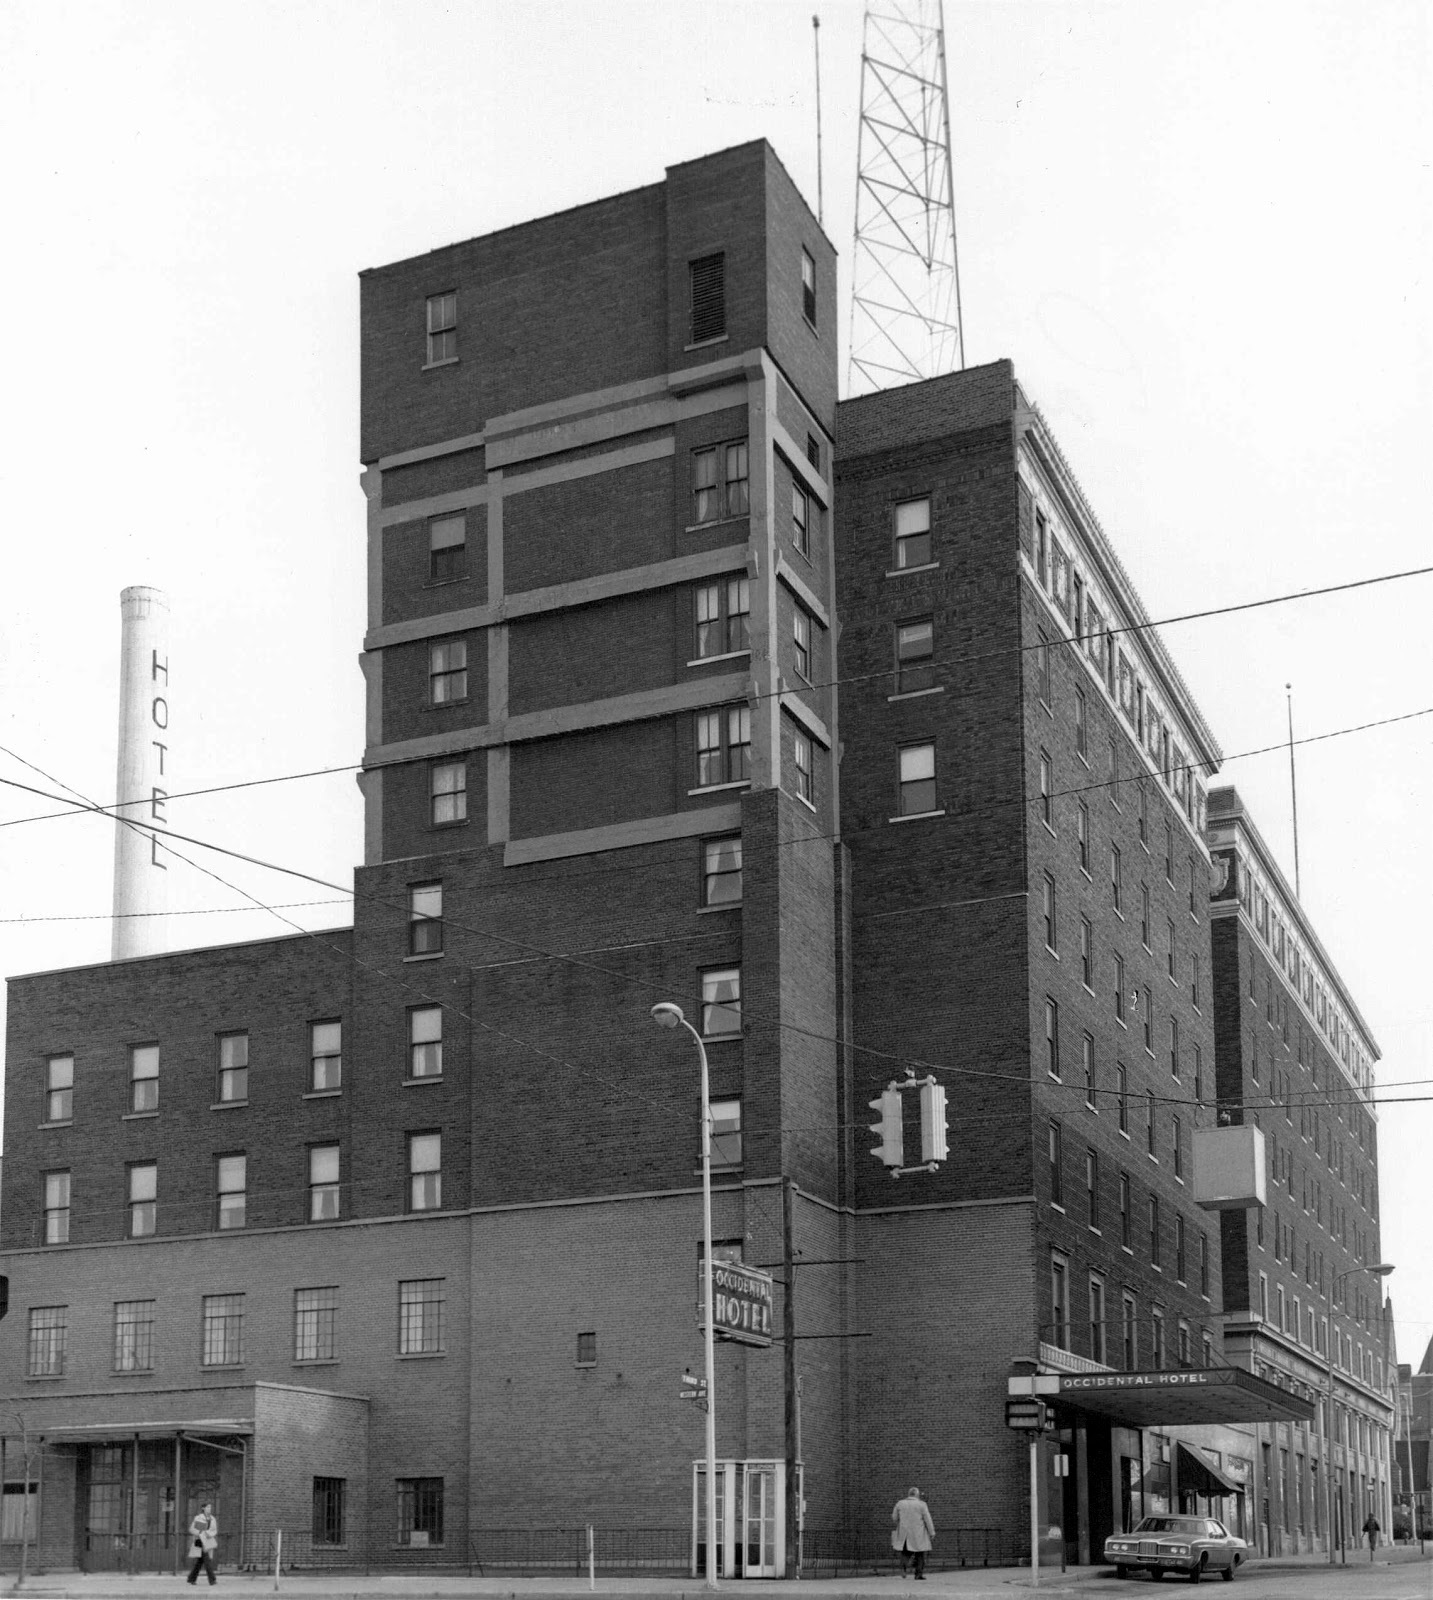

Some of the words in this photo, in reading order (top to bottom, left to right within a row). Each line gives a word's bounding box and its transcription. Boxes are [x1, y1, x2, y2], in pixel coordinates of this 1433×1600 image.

[151, 648, 169, 871] HOTEL
[715, 1269, 772, 1303] OCCIDENTAL
[715, 1292, 772, 1334] HOTEL
[1064, 1375, 1153, 1388] OCCIDENTAL
[1159, 1373, 1208, 1384] HOTEL
